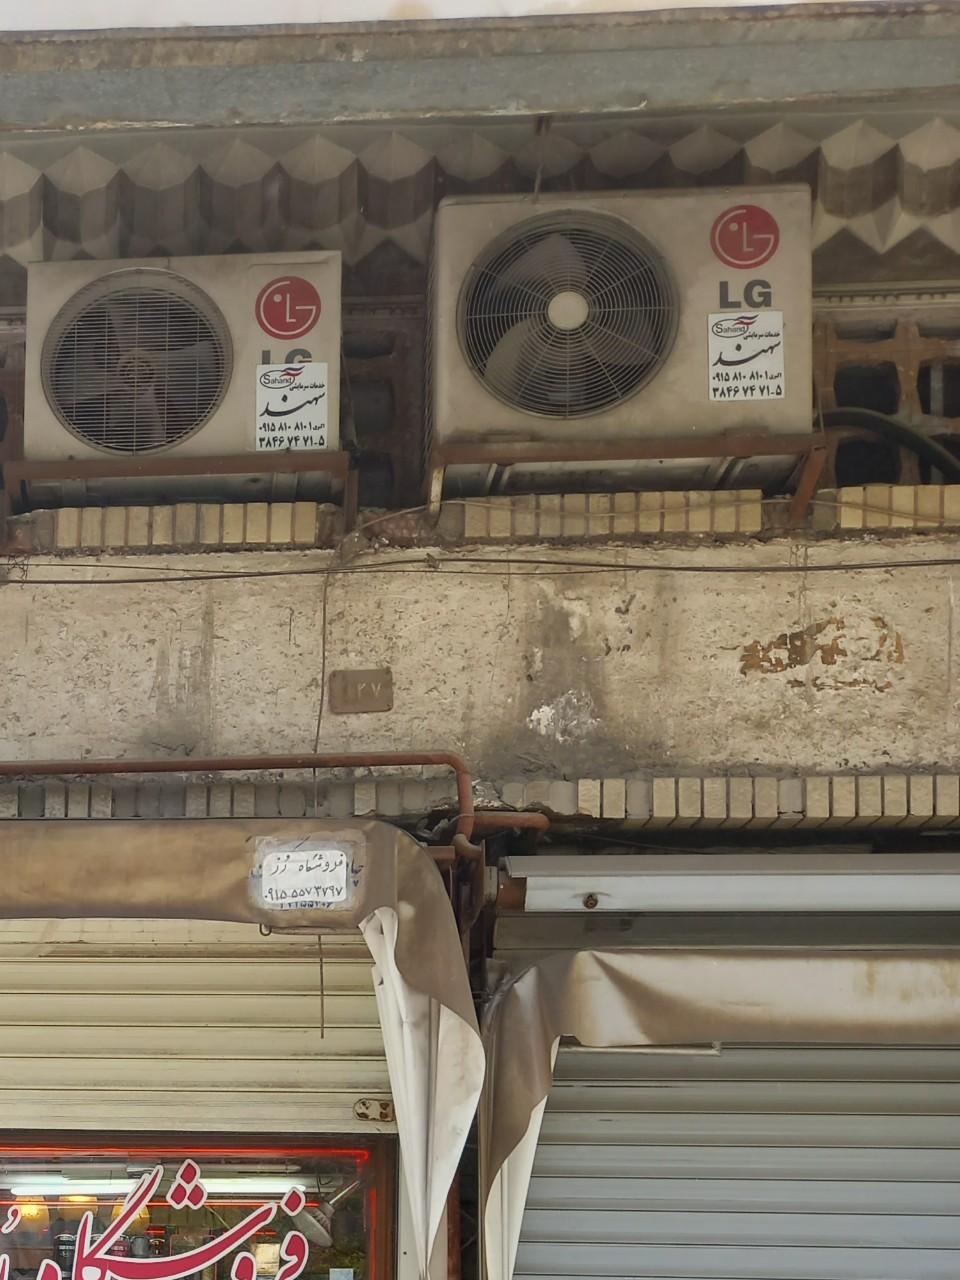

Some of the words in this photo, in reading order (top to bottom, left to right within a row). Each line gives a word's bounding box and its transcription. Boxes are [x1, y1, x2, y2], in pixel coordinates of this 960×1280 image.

[719, 279, 772, 308] LG
[712, 341, 781, 367] سهند
[259, 392, 325, 417] سهند
[299, 853, 344, 873] فروشگاه
